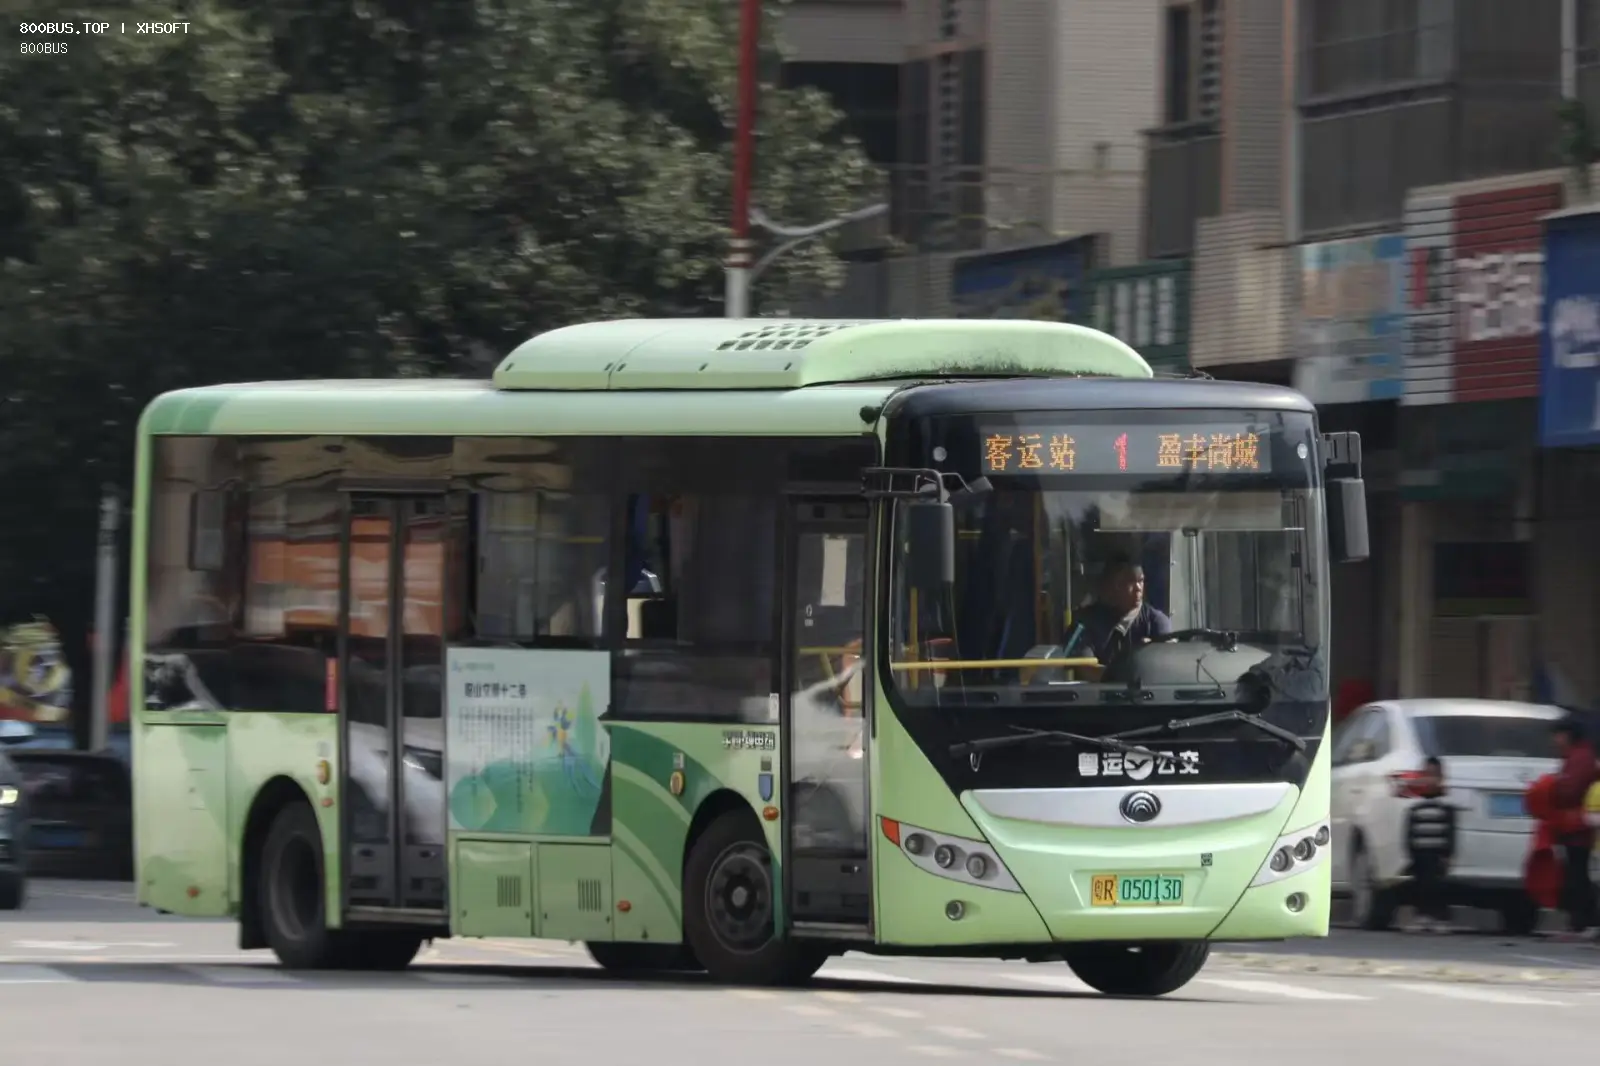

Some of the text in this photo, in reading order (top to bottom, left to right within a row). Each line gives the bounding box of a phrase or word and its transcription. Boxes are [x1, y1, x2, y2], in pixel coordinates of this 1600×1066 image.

[985, 432, 1260, 472] 客运站 1 盈丰尚城
[1157, 750, 1200, 775] 公交
